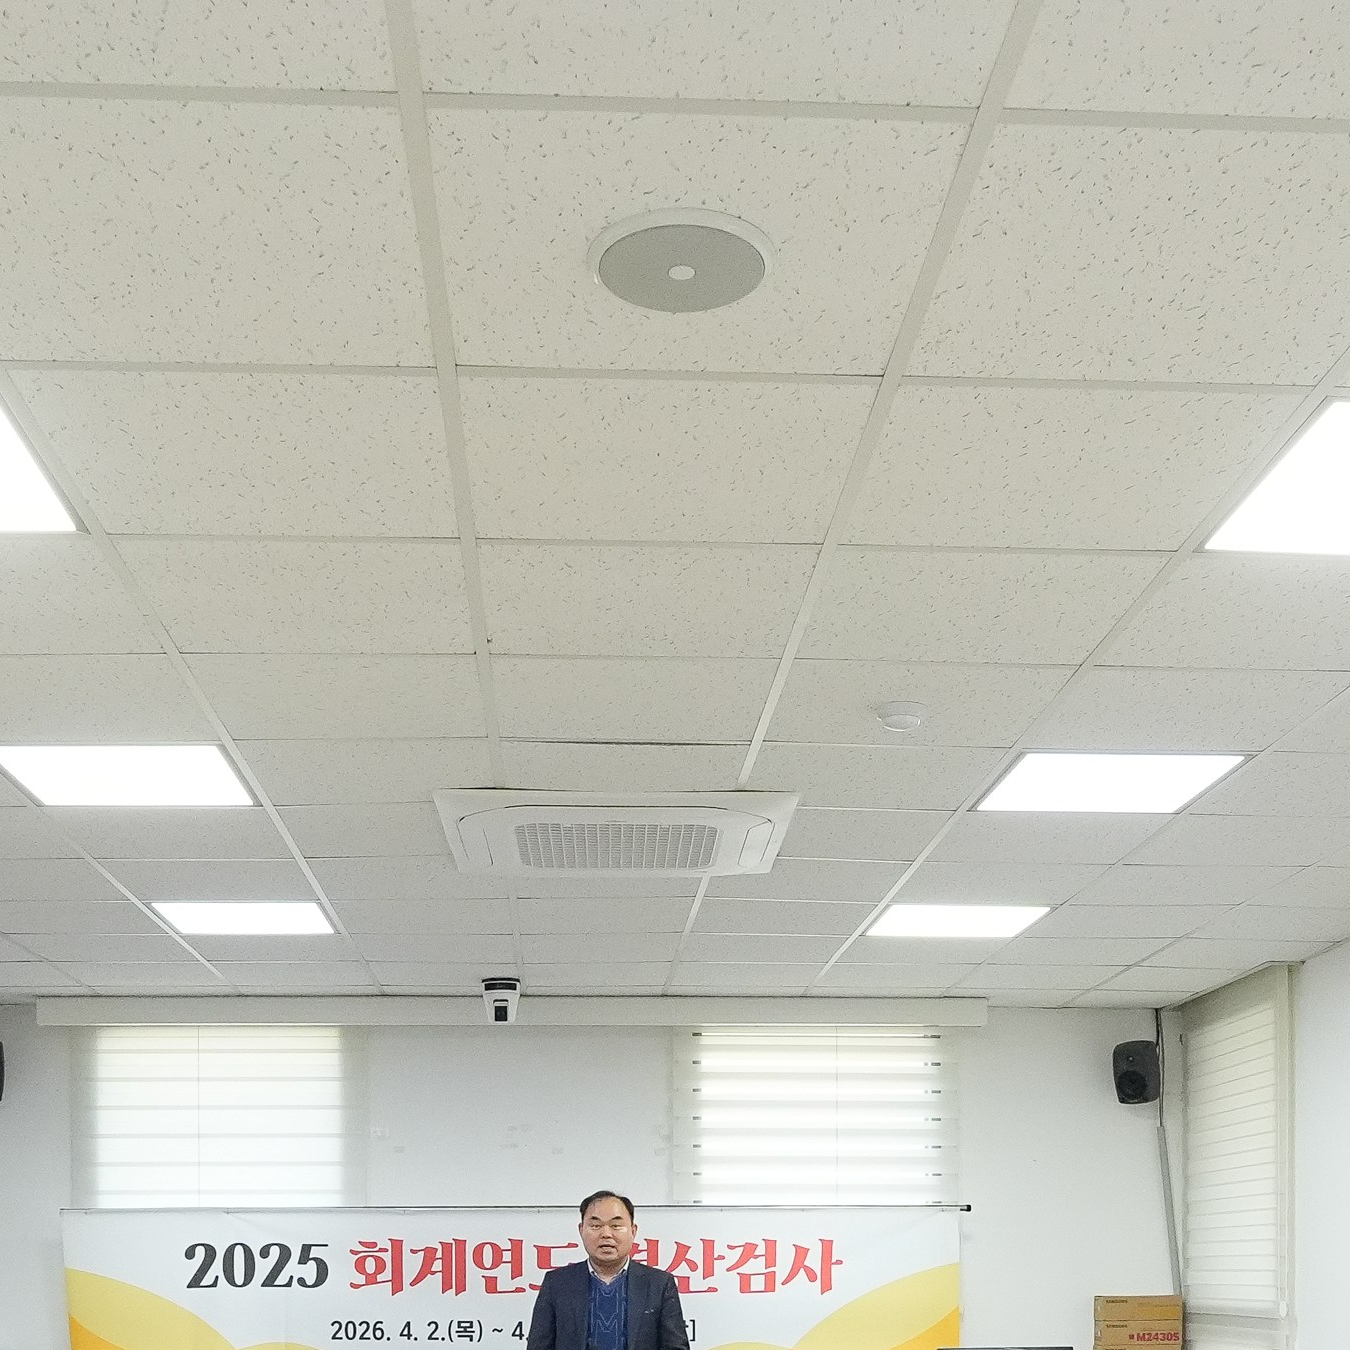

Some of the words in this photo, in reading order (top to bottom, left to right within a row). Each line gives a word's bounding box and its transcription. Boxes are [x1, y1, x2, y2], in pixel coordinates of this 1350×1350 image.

[184, 1242, 330, 1289] 2025
[330, 1320, 391, 1342] 2026.
[399, 1320, 419, 1342] 4.
[1136, 1332, 1180, 1342] M2430S
